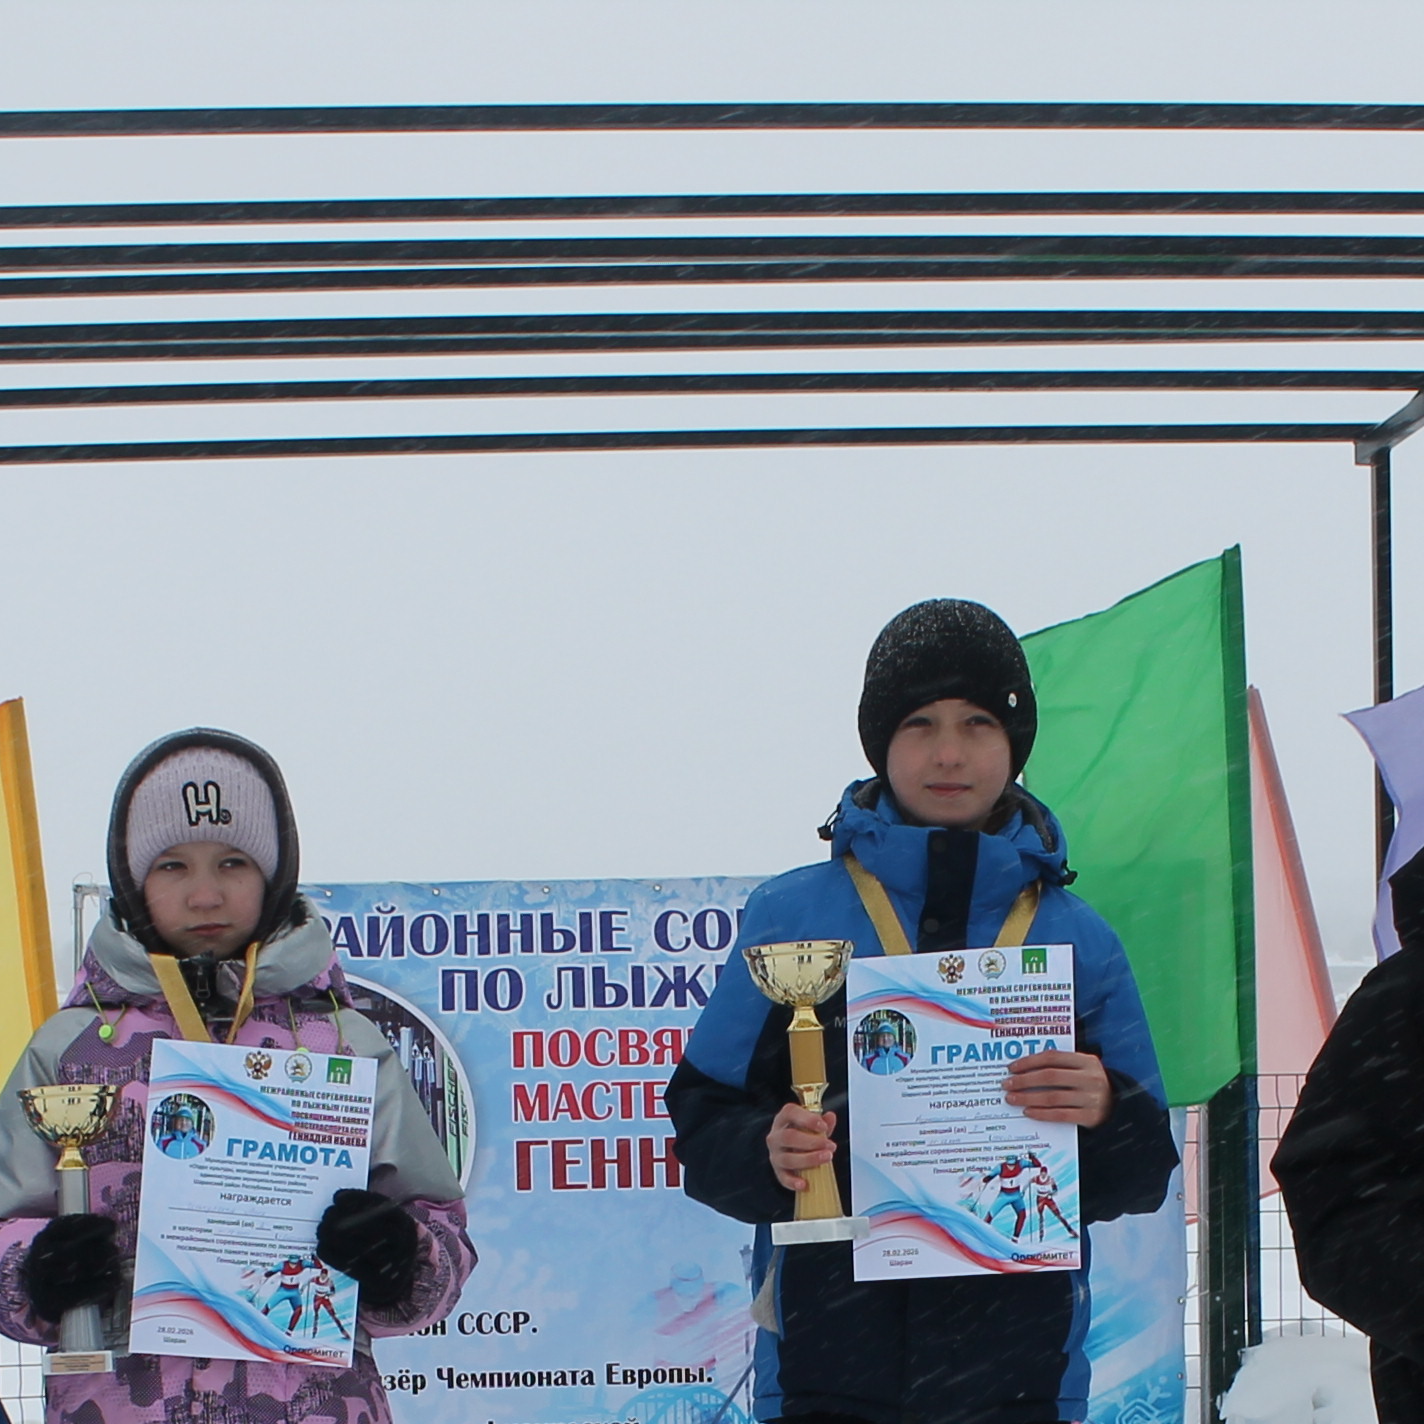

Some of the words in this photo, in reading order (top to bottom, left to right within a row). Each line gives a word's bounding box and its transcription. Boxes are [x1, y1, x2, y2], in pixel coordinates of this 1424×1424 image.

[440, 968, 524, 1013] ПО
[546, 965, 718, 1010] ЛЫЖ
[930, 1038, 1058, 1065] ГРАМОТА
[929, 1097, 1000, 1110] награждается
[226, 1138, 353, 1169] ГРАМОТА
[220, 1192, 291, 1206] награждается
[458, 1312, 538, 1335] СССР.
[437, 1366, 595, 1389] Чемпионата
[606, 1363, 712, 1389] Европы.
